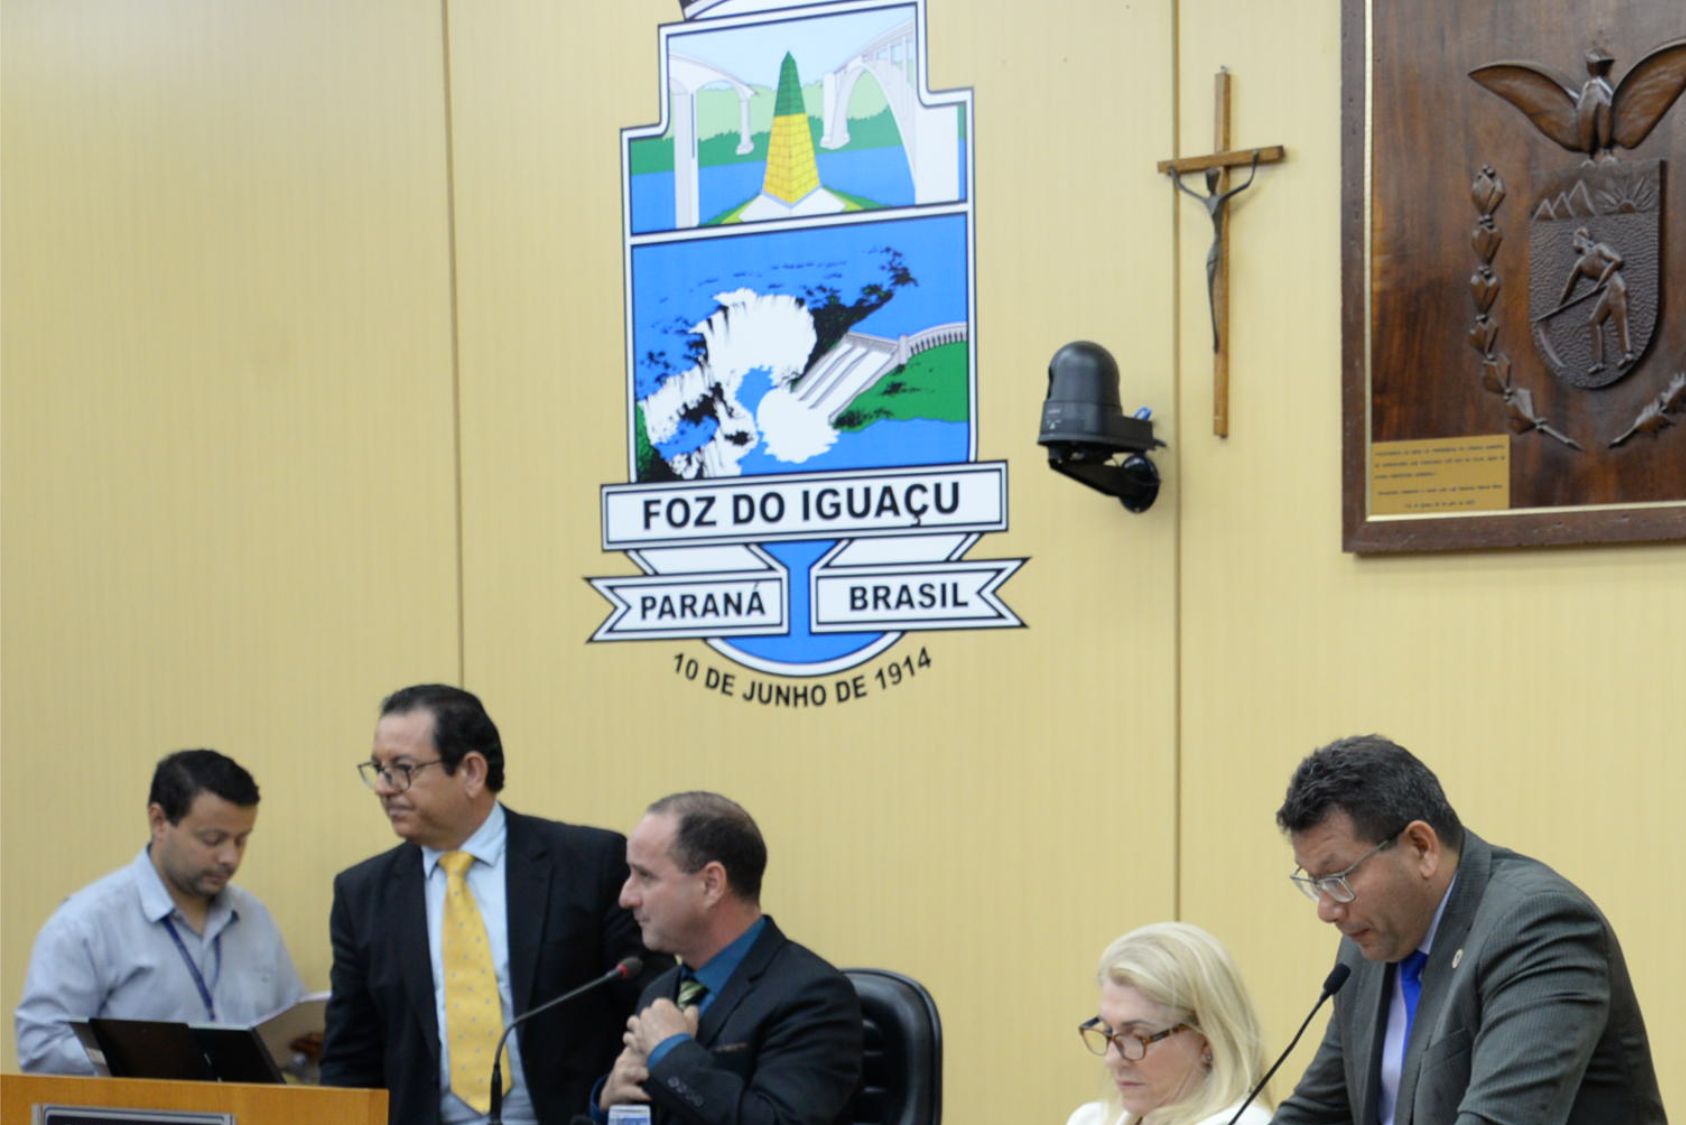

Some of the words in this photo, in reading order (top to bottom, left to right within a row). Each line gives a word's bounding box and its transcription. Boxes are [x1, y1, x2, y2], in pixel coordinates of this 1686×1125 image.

[642, 495, 718, 530] FOZ
[731, 489, 786, 521] DO
[801, 480, 961, 528] IGUAÇU
[639, 582, 767, 622] PARANÁ
[849, 582, 969, 611] BRASIL
[671, 651, 700, 679] 10
[704, 666, 736, 698] DE
[742, 679, 828, 709] JUNHO
[835, 674, 869, 702] DE
[874, 647, 933, 691] 1914
